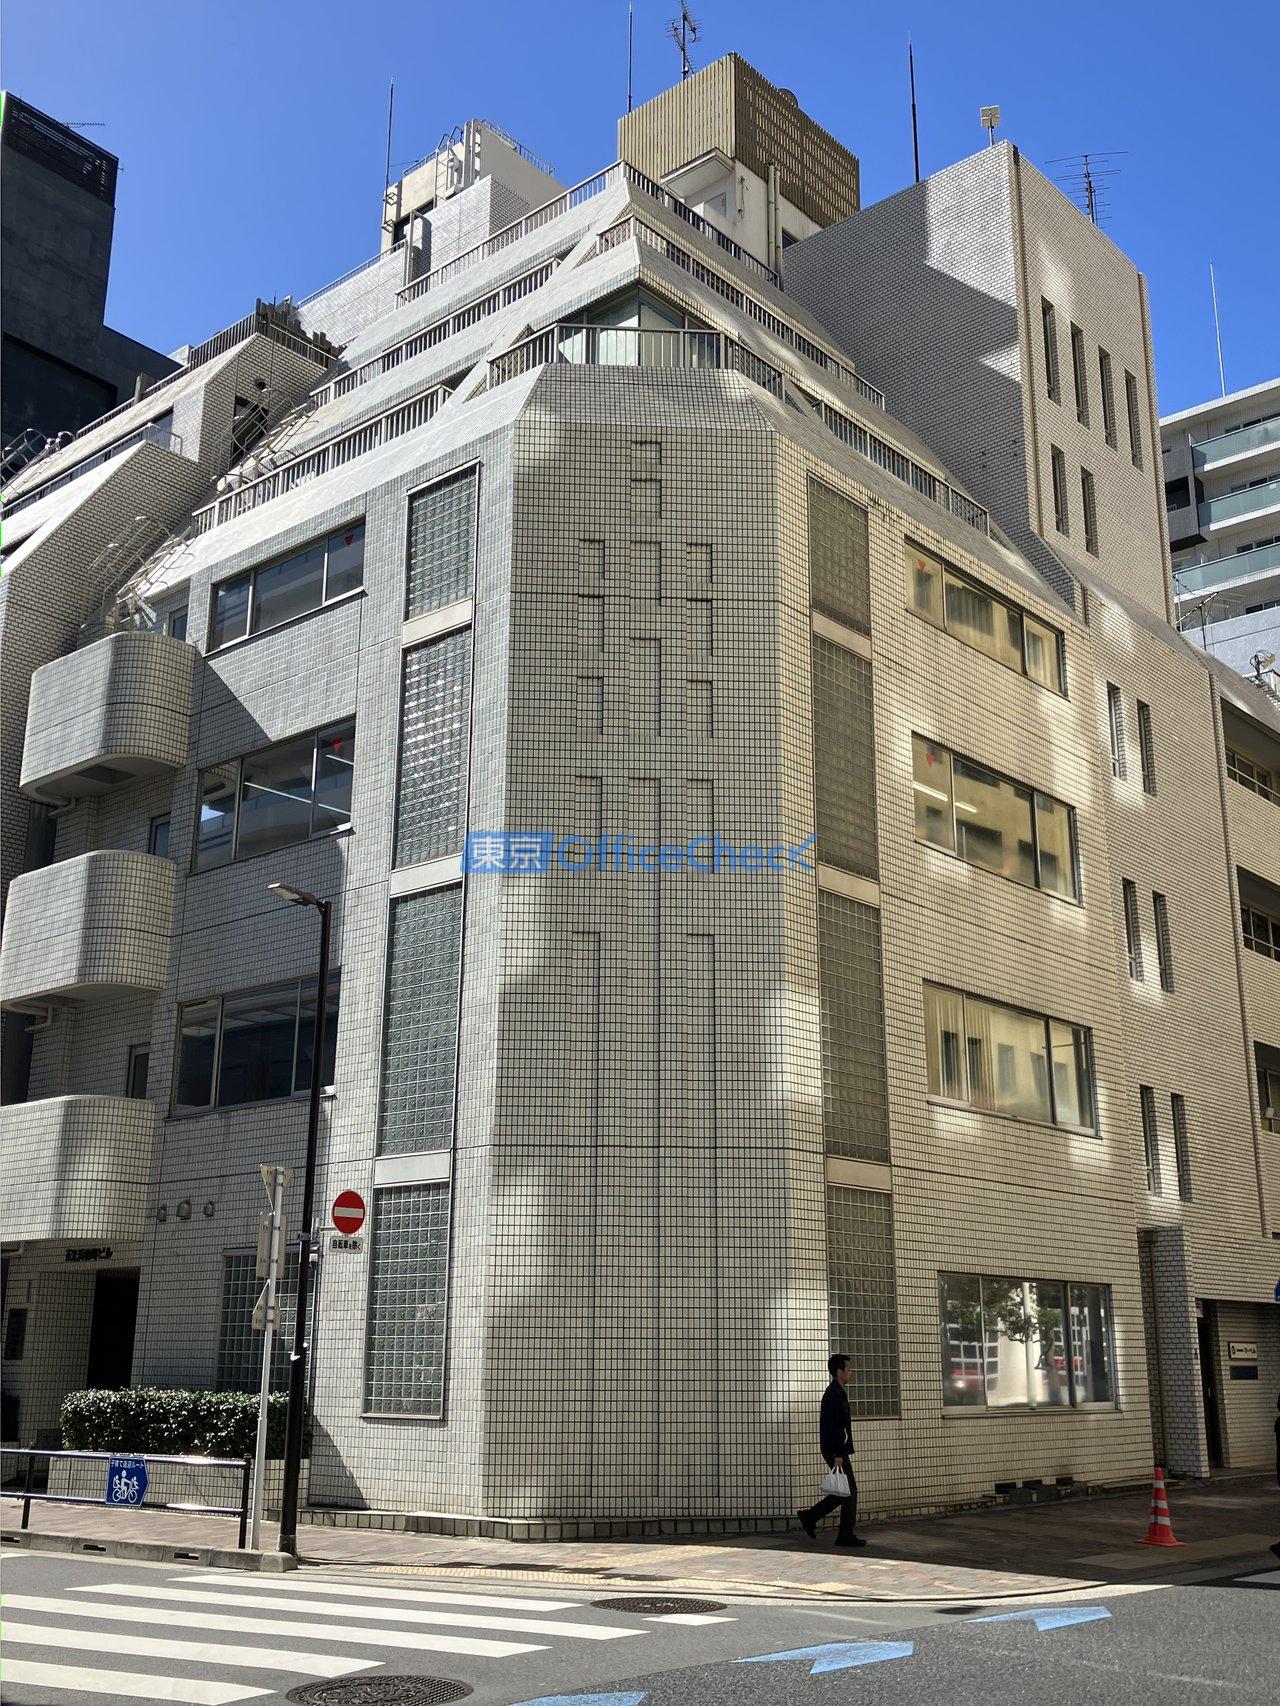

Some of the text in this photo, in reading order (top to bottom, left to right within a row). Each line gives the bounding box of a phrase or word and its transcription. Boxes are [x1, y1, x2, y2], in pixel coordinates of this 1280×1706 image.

[332, 1239, 361, 1250] 自転車を除く
